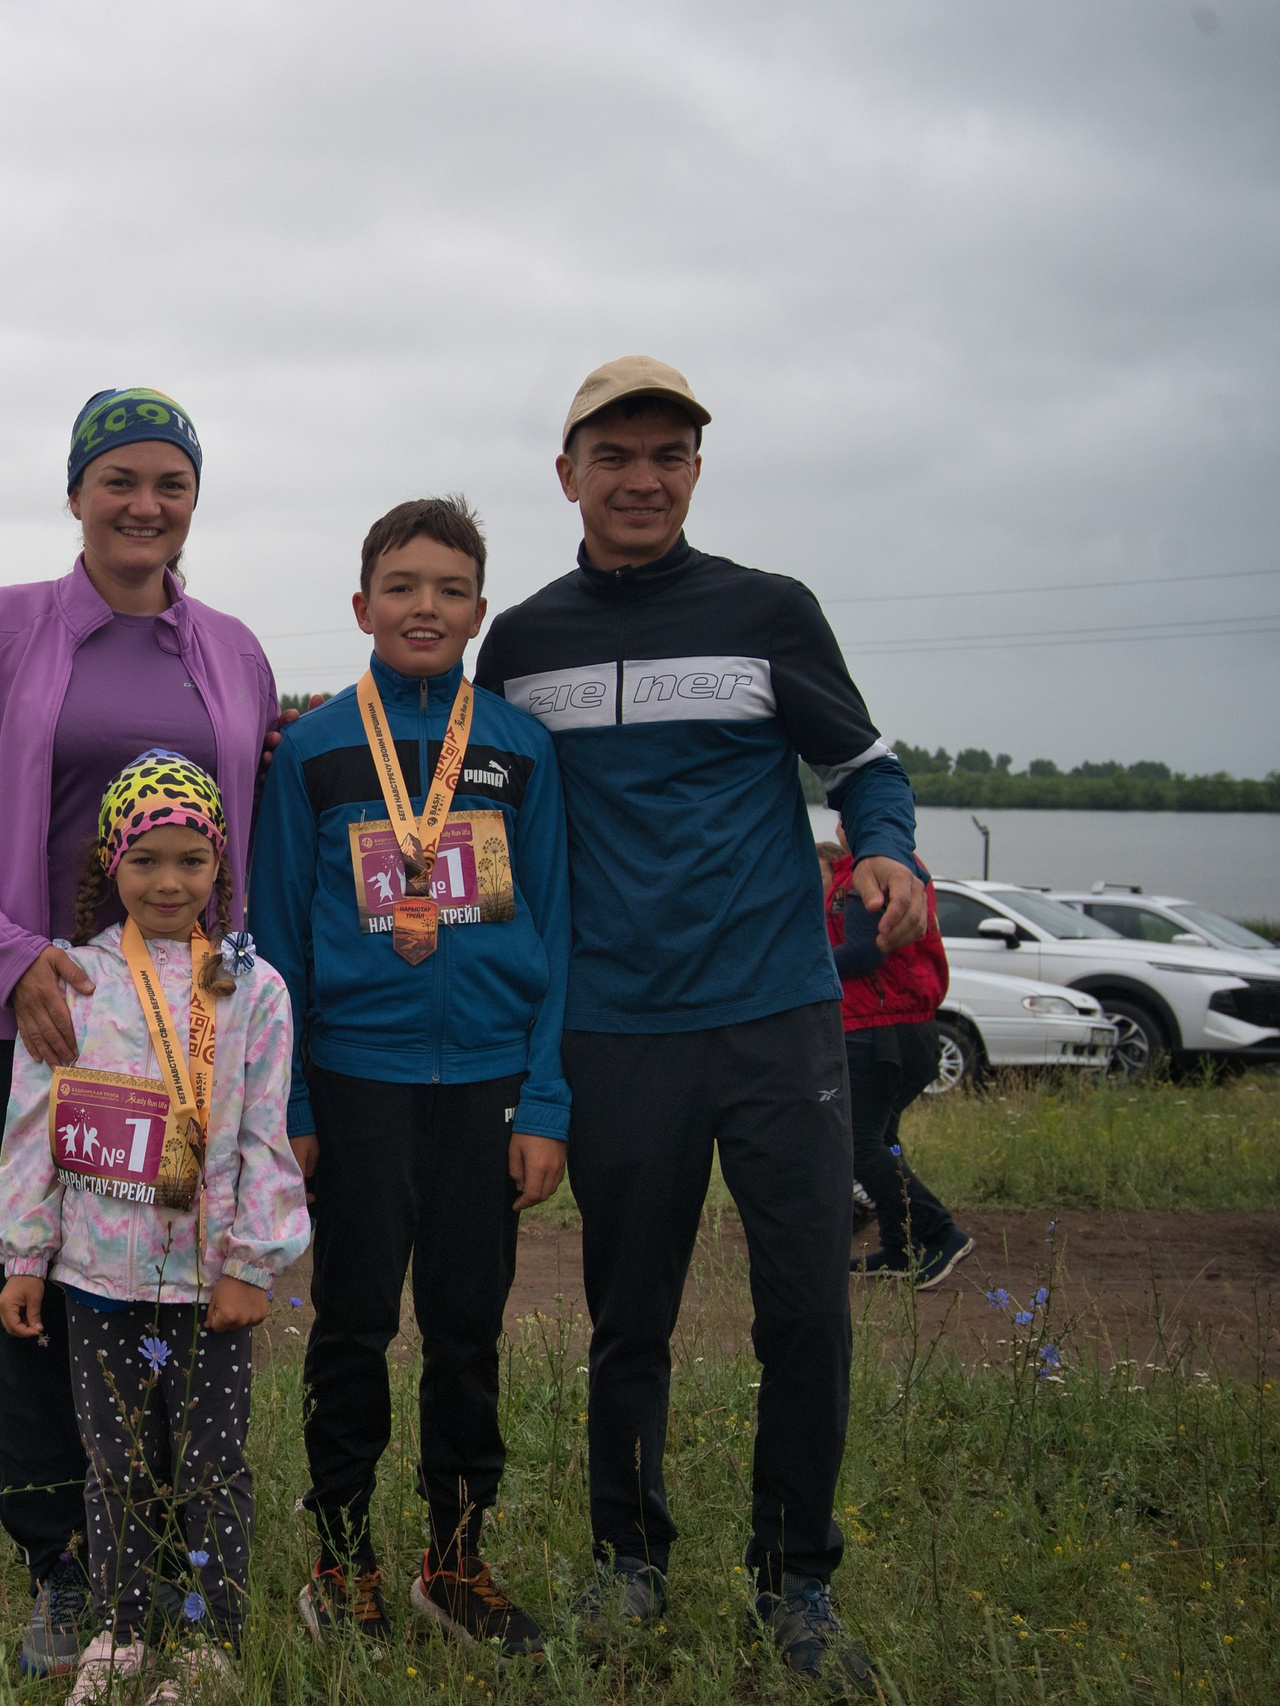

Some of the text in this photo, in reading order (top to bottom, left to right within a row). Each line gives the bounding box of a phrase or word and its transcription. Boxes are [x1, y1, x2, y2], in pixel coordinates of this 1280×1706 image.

[368, 703, 407, 821] БЕГИ НАВСТРЕЧУ СВОИМ ВЕРШИНАМ
[464, 769, 503, 788] PUMA
[430, 794, 441, 815] BASH
[141, 971, 187, 1105] БЕГИ НАВСТРЕЧУ СВОИМ ВЕРШИНАМ
[195, 1072, 203, 1097] BASH
